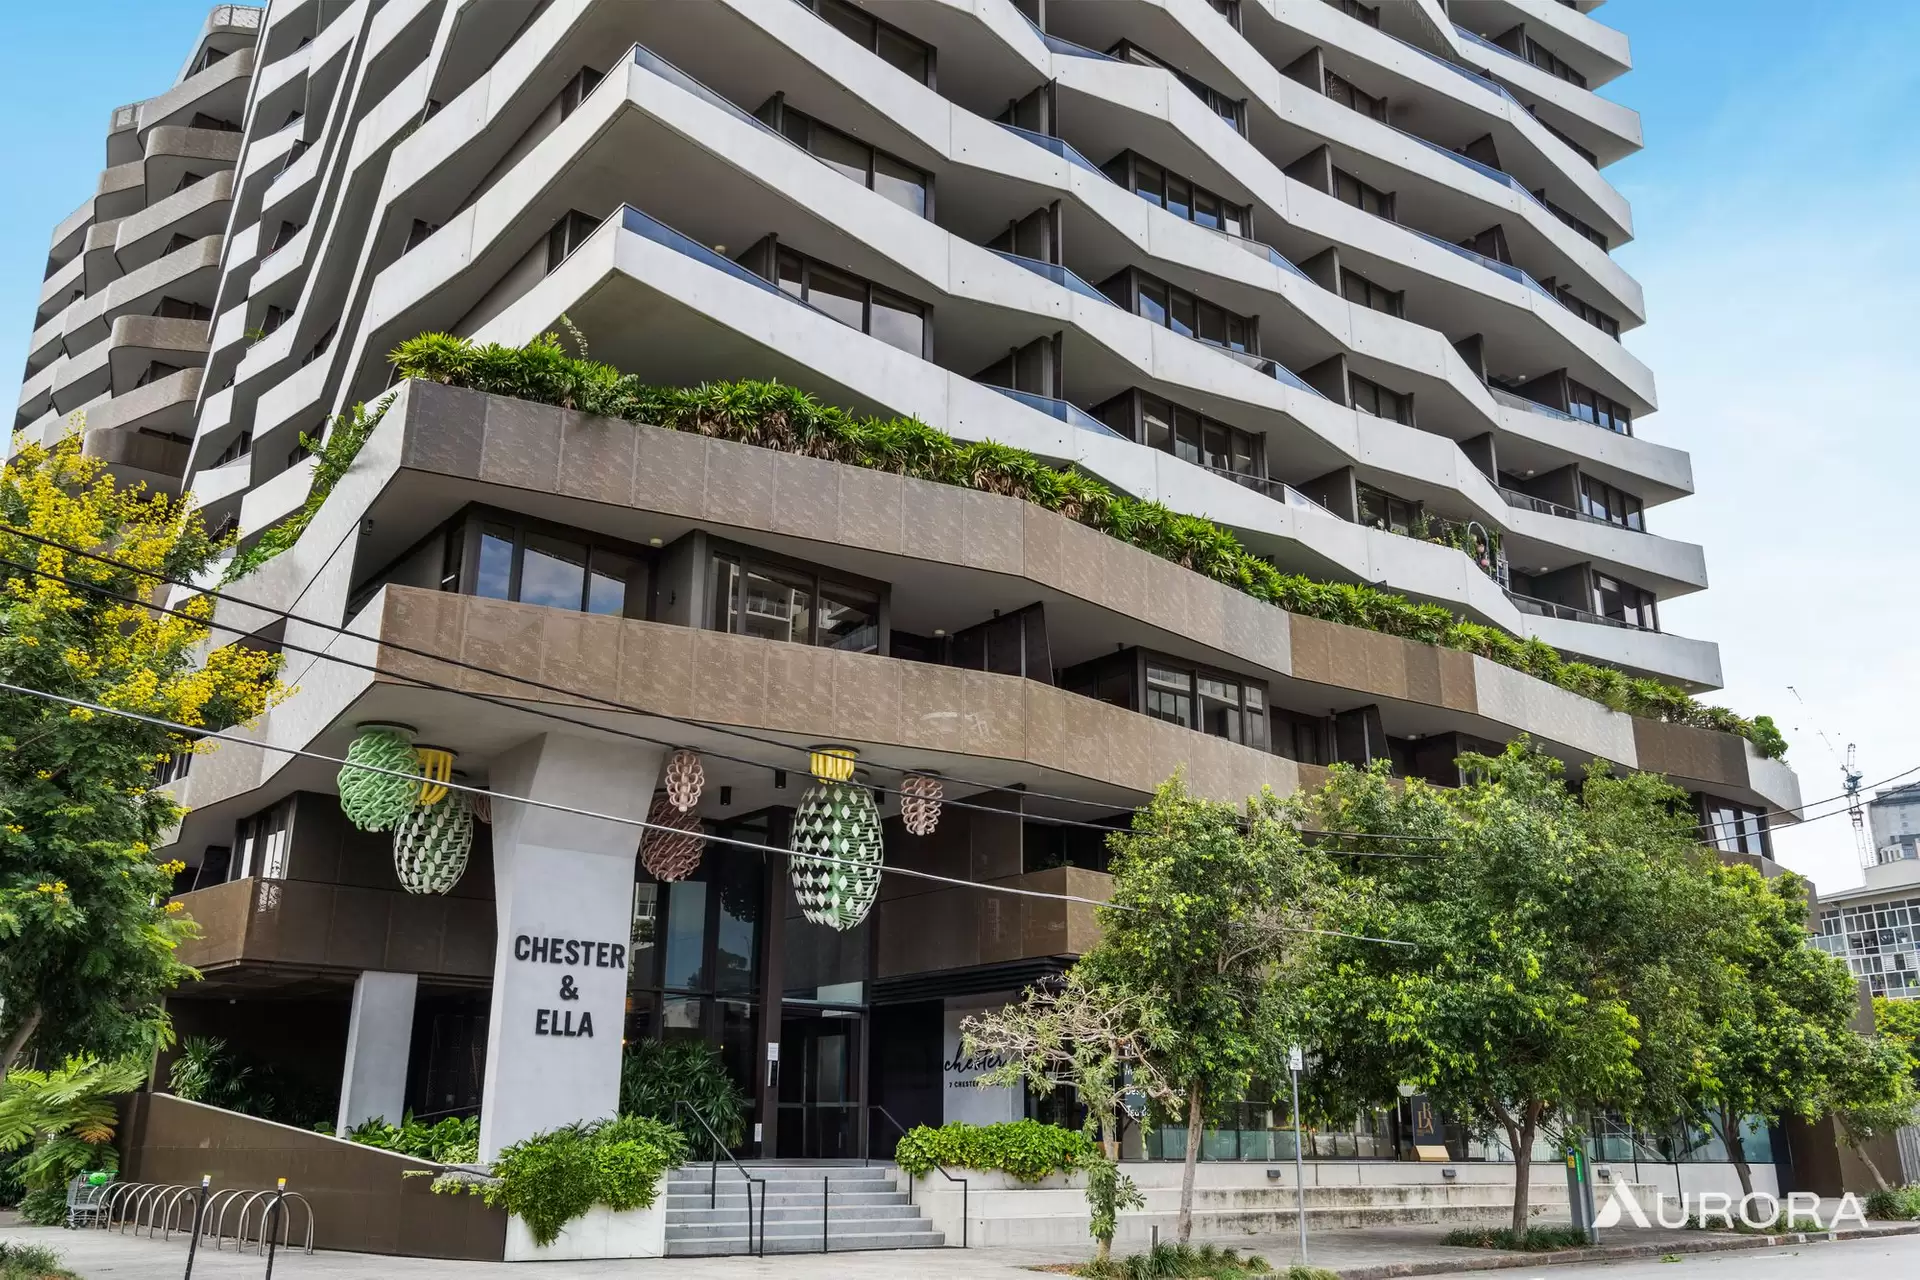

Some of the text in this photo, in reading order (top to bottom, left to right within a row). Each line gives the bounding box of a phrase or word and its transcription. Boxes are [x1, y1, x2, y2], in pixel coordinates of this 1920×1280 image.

[514, 934, 626, 969] CHESTER
[559, 975, 579, 1001] &
[535, 1008, 594, 1038] ELLA
